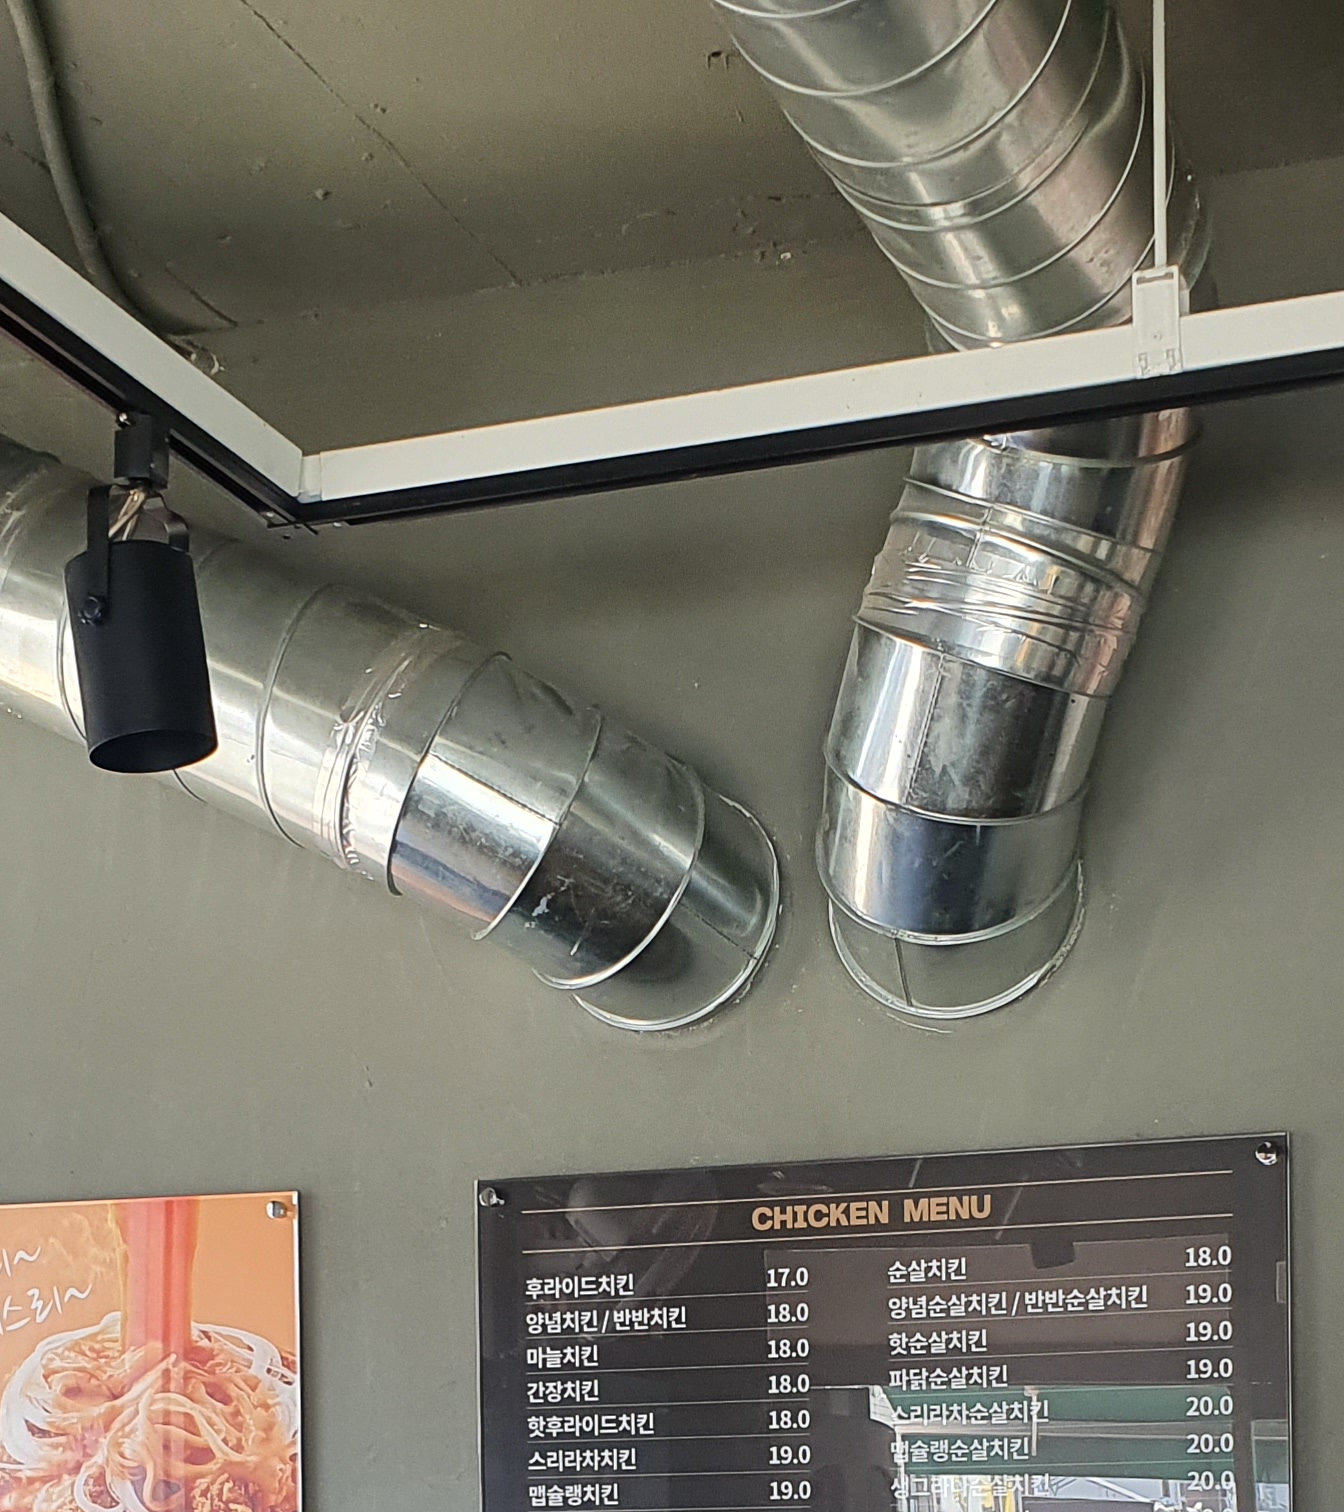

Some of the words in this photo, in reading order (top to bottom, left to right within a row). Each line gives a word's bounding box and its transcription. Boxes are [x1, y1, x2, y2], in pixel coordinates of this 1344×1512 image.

[751, 1201, 889, 1232] CHICKEN
[904, 1195, 992, 1223] MENU
[887, 1257, 967, 1283] 순살치킨
[1185, 1246, 1232, 1267] 18.0
[525, 1274, 634, 1298] 후라이드치킨
[766, 1268, 808, 1287] 17.0
[888, 1292, 1007, 1319] 양념순살치킨
[1024, 1285, 1148, 1313] 반반순살치킨
[1185, 1284, 1232, 1304] 19.0
[526, 1310, 598, 1334] 양념치킨
[613, 1306, 686, 1330] 반반치킨
[767, 1303, 808, 1322] 18.0
[888, 1329, 987, 1355] 핫순살치킨
[1185, 1321, 1233, 1341] 19.0
[526, 1345, 598, 1368] 마늘치킨
[767, 1339, 809, 1358] 18.0
[526, 1380, 599, 1403] 간장치킨
[768, 1375, 810, 1393] 18.0
[888, 1365, 1008, 1391] 파닭순살치킨
[1186, 1358, 1233, 1379] 19.0
[1186, 1396, 1233, 1417] 20.0
[527, 1414, 654, 1438] 핫후라이드치킨
[768, 1410, 810, 1429] 18.0
[1186, 1433, 1234, 1454] 20.0
[528, 1449, 637, 1471] 스리라차치킨
[769, 1446, 811, 1464] 19.0
[529, 1484, 619, 1506] 맵슐랭치킨
[769, 1481, 811, 1500] 19.0
[1187, 1470, 1235, 1491] 20.0
